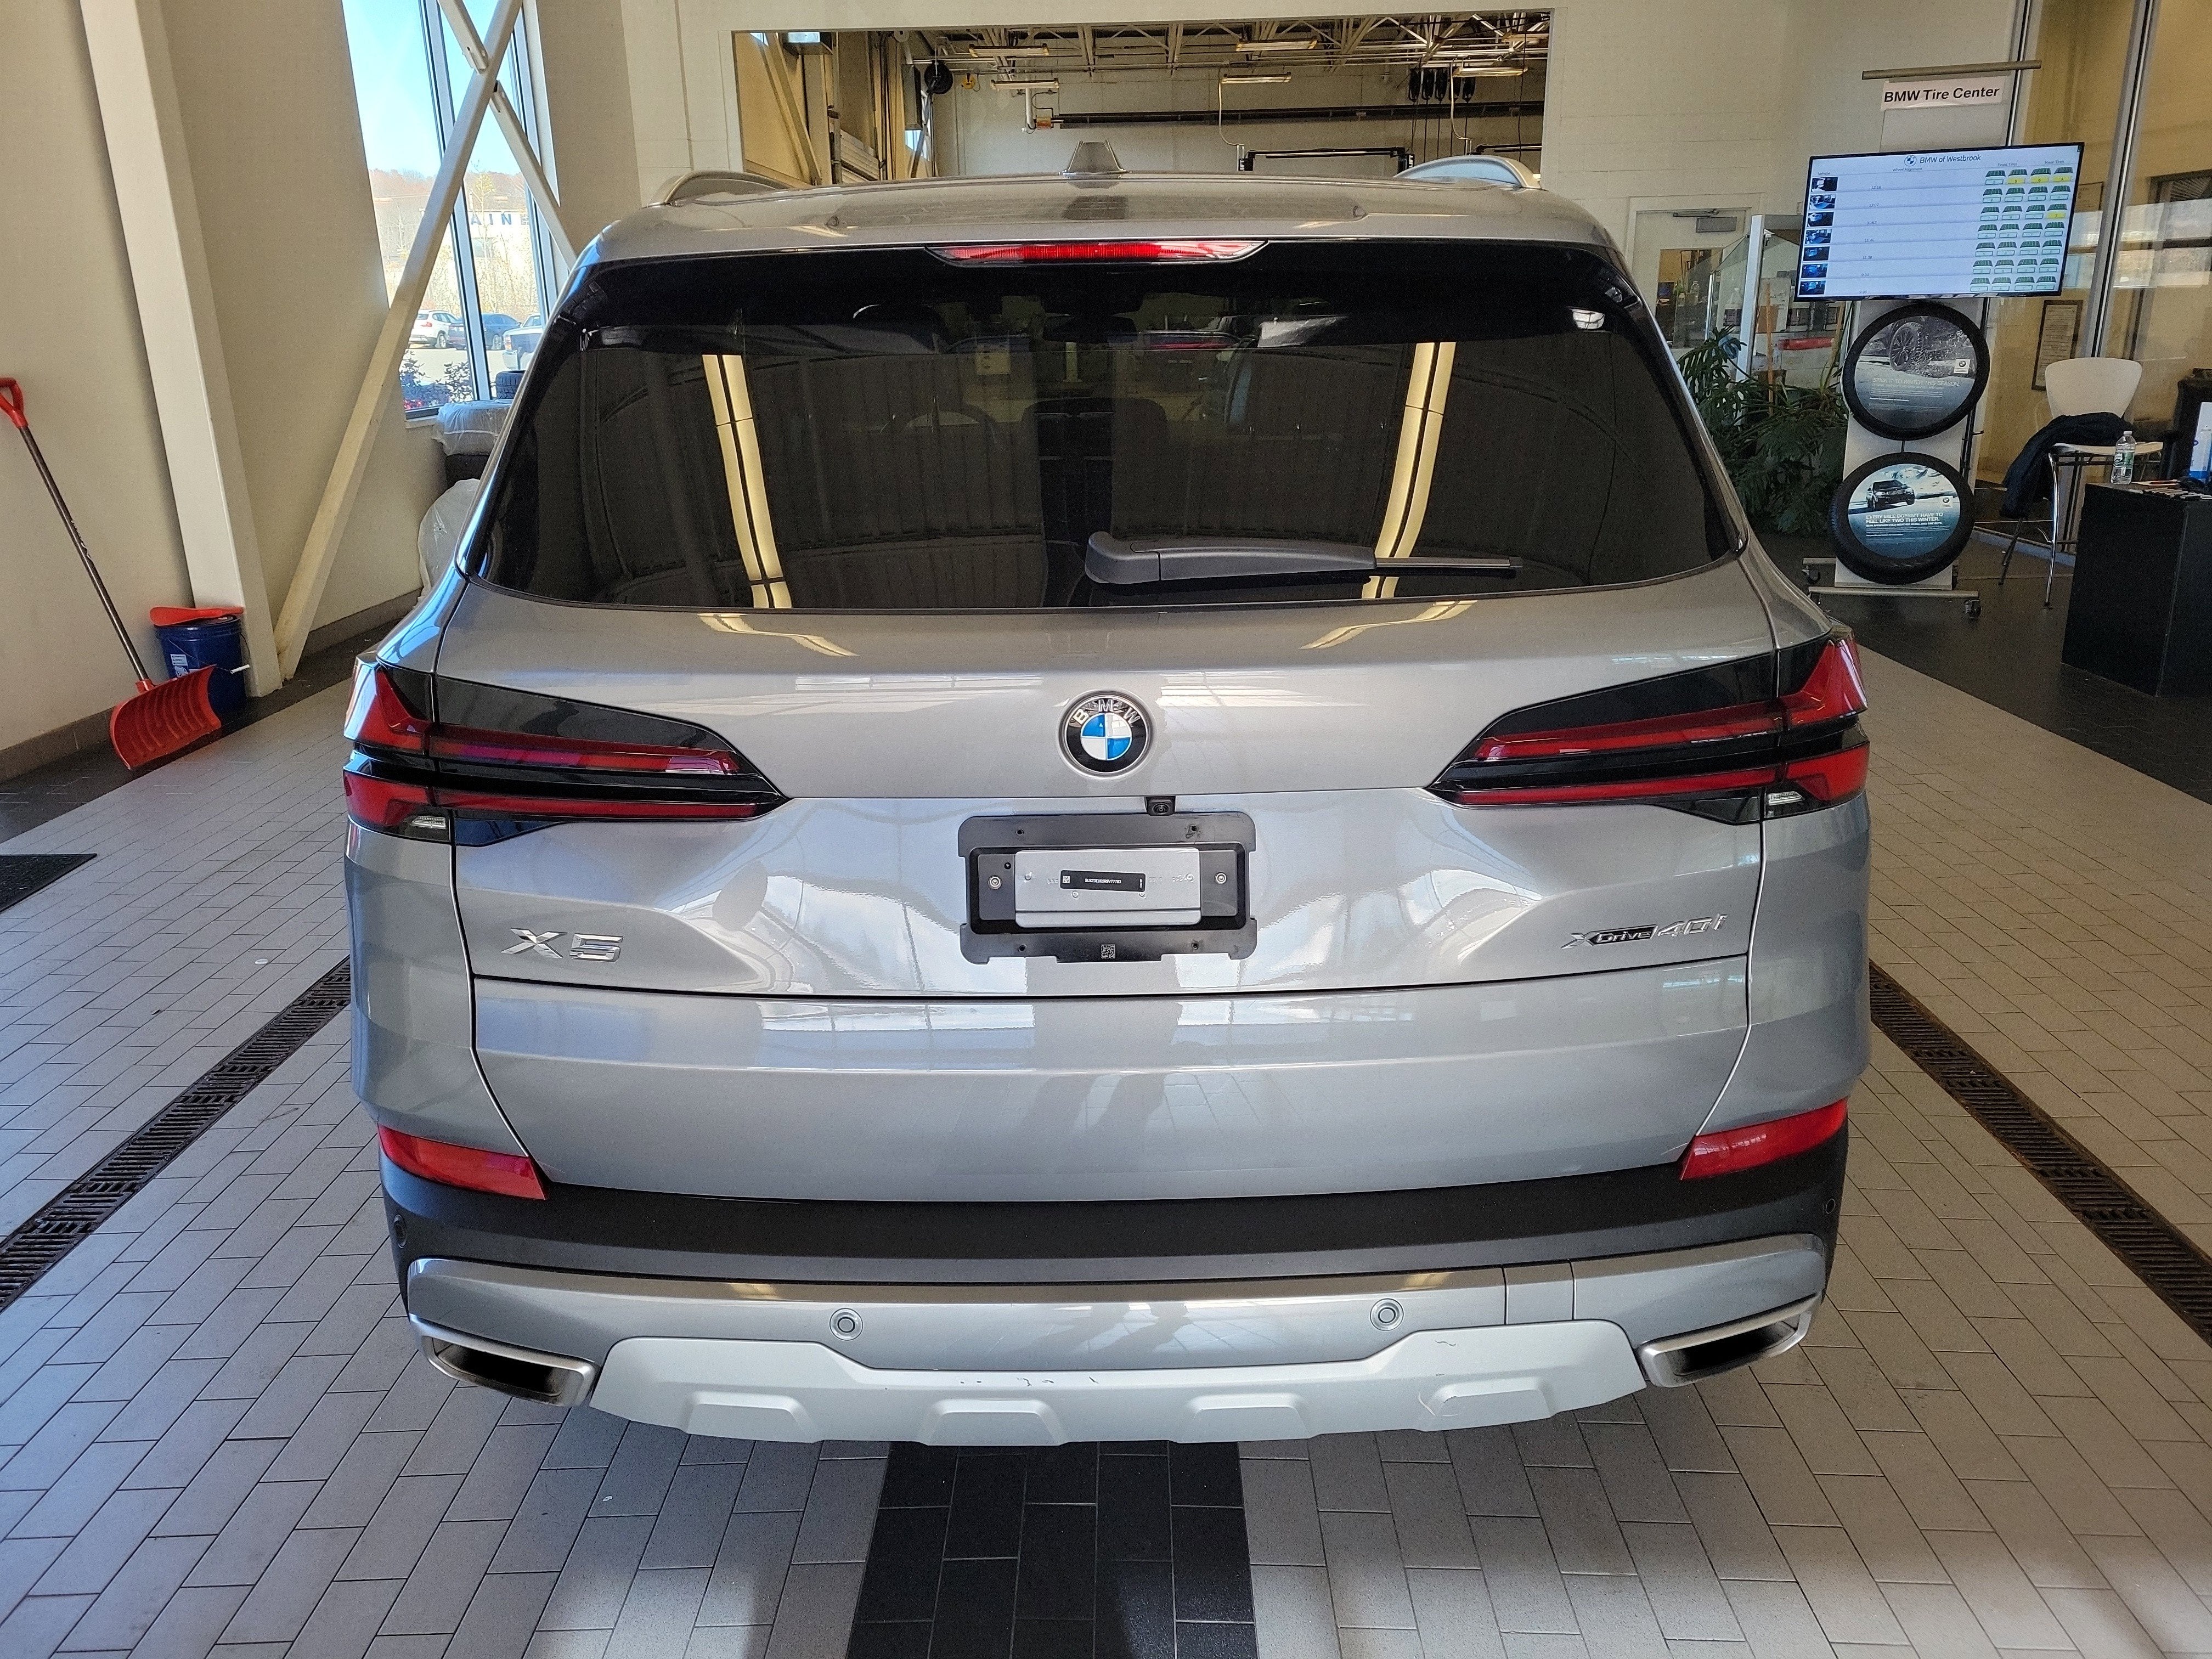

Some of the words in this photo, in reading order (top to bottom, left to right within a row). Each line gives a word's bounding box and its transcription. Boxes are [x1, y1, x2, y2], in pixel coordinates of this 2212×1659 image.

[1884, 89, 1921, 103] BMW
[1923, 89, 1949, 100] Tire
[1953, 87, 2000, 99] Center
[471, 213, 530, 225] AINE
[1073, 699, 1141, 727] BMW
[500, 927, 624, 963] X5
